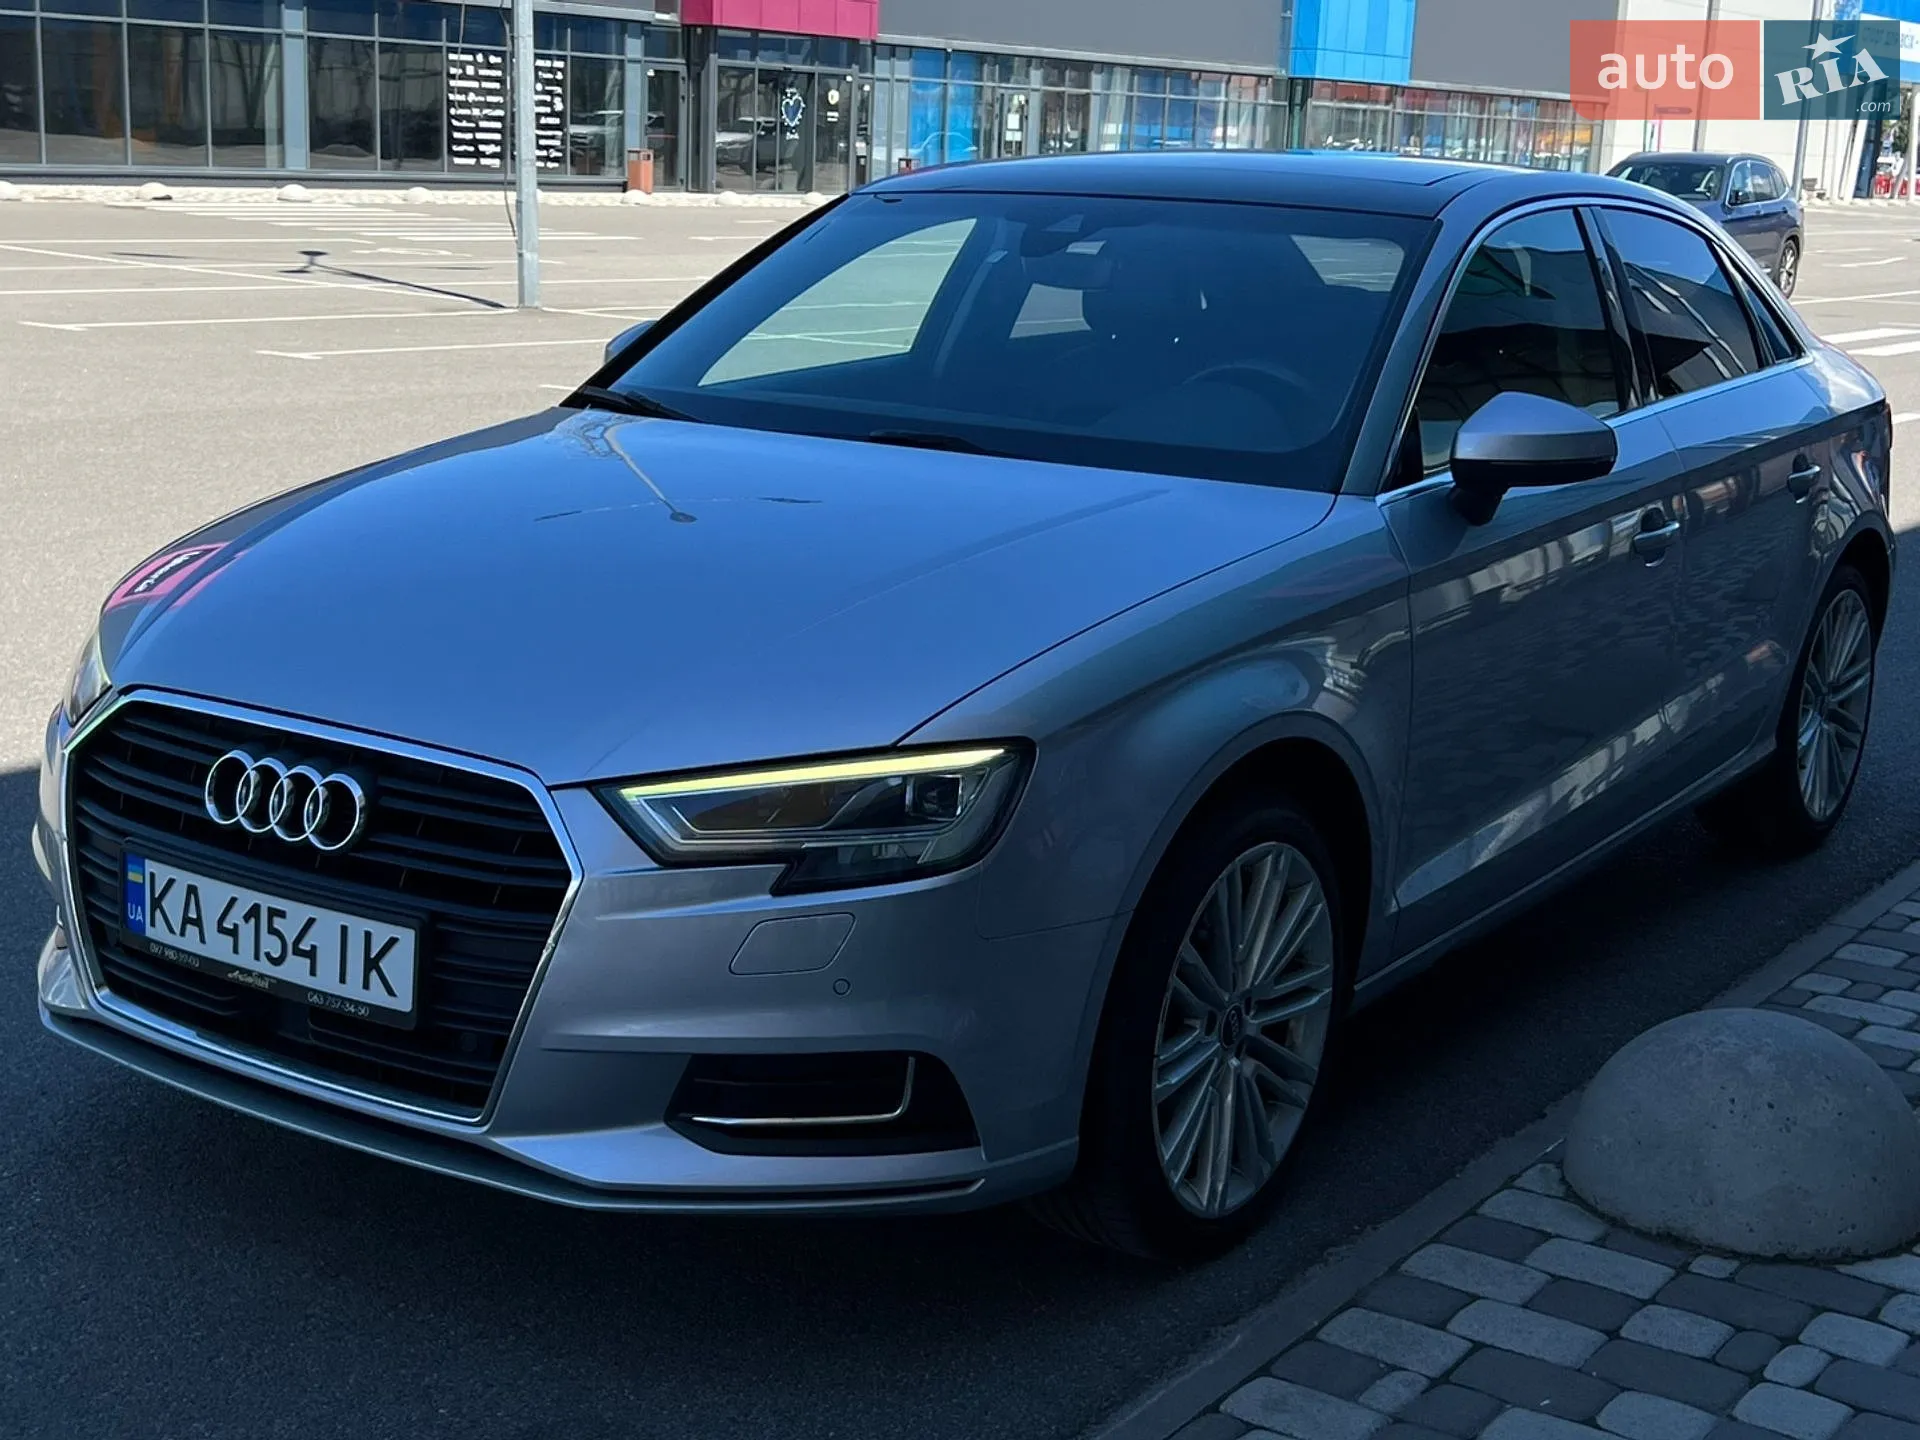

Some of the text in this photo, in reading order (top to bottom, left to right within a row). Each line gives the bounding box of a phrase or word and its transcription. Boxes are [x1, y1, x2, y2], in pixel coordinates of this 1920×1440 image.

[128, 902, 144, 923] UA
[149, 871, 400, 998] KA 4154 IK
